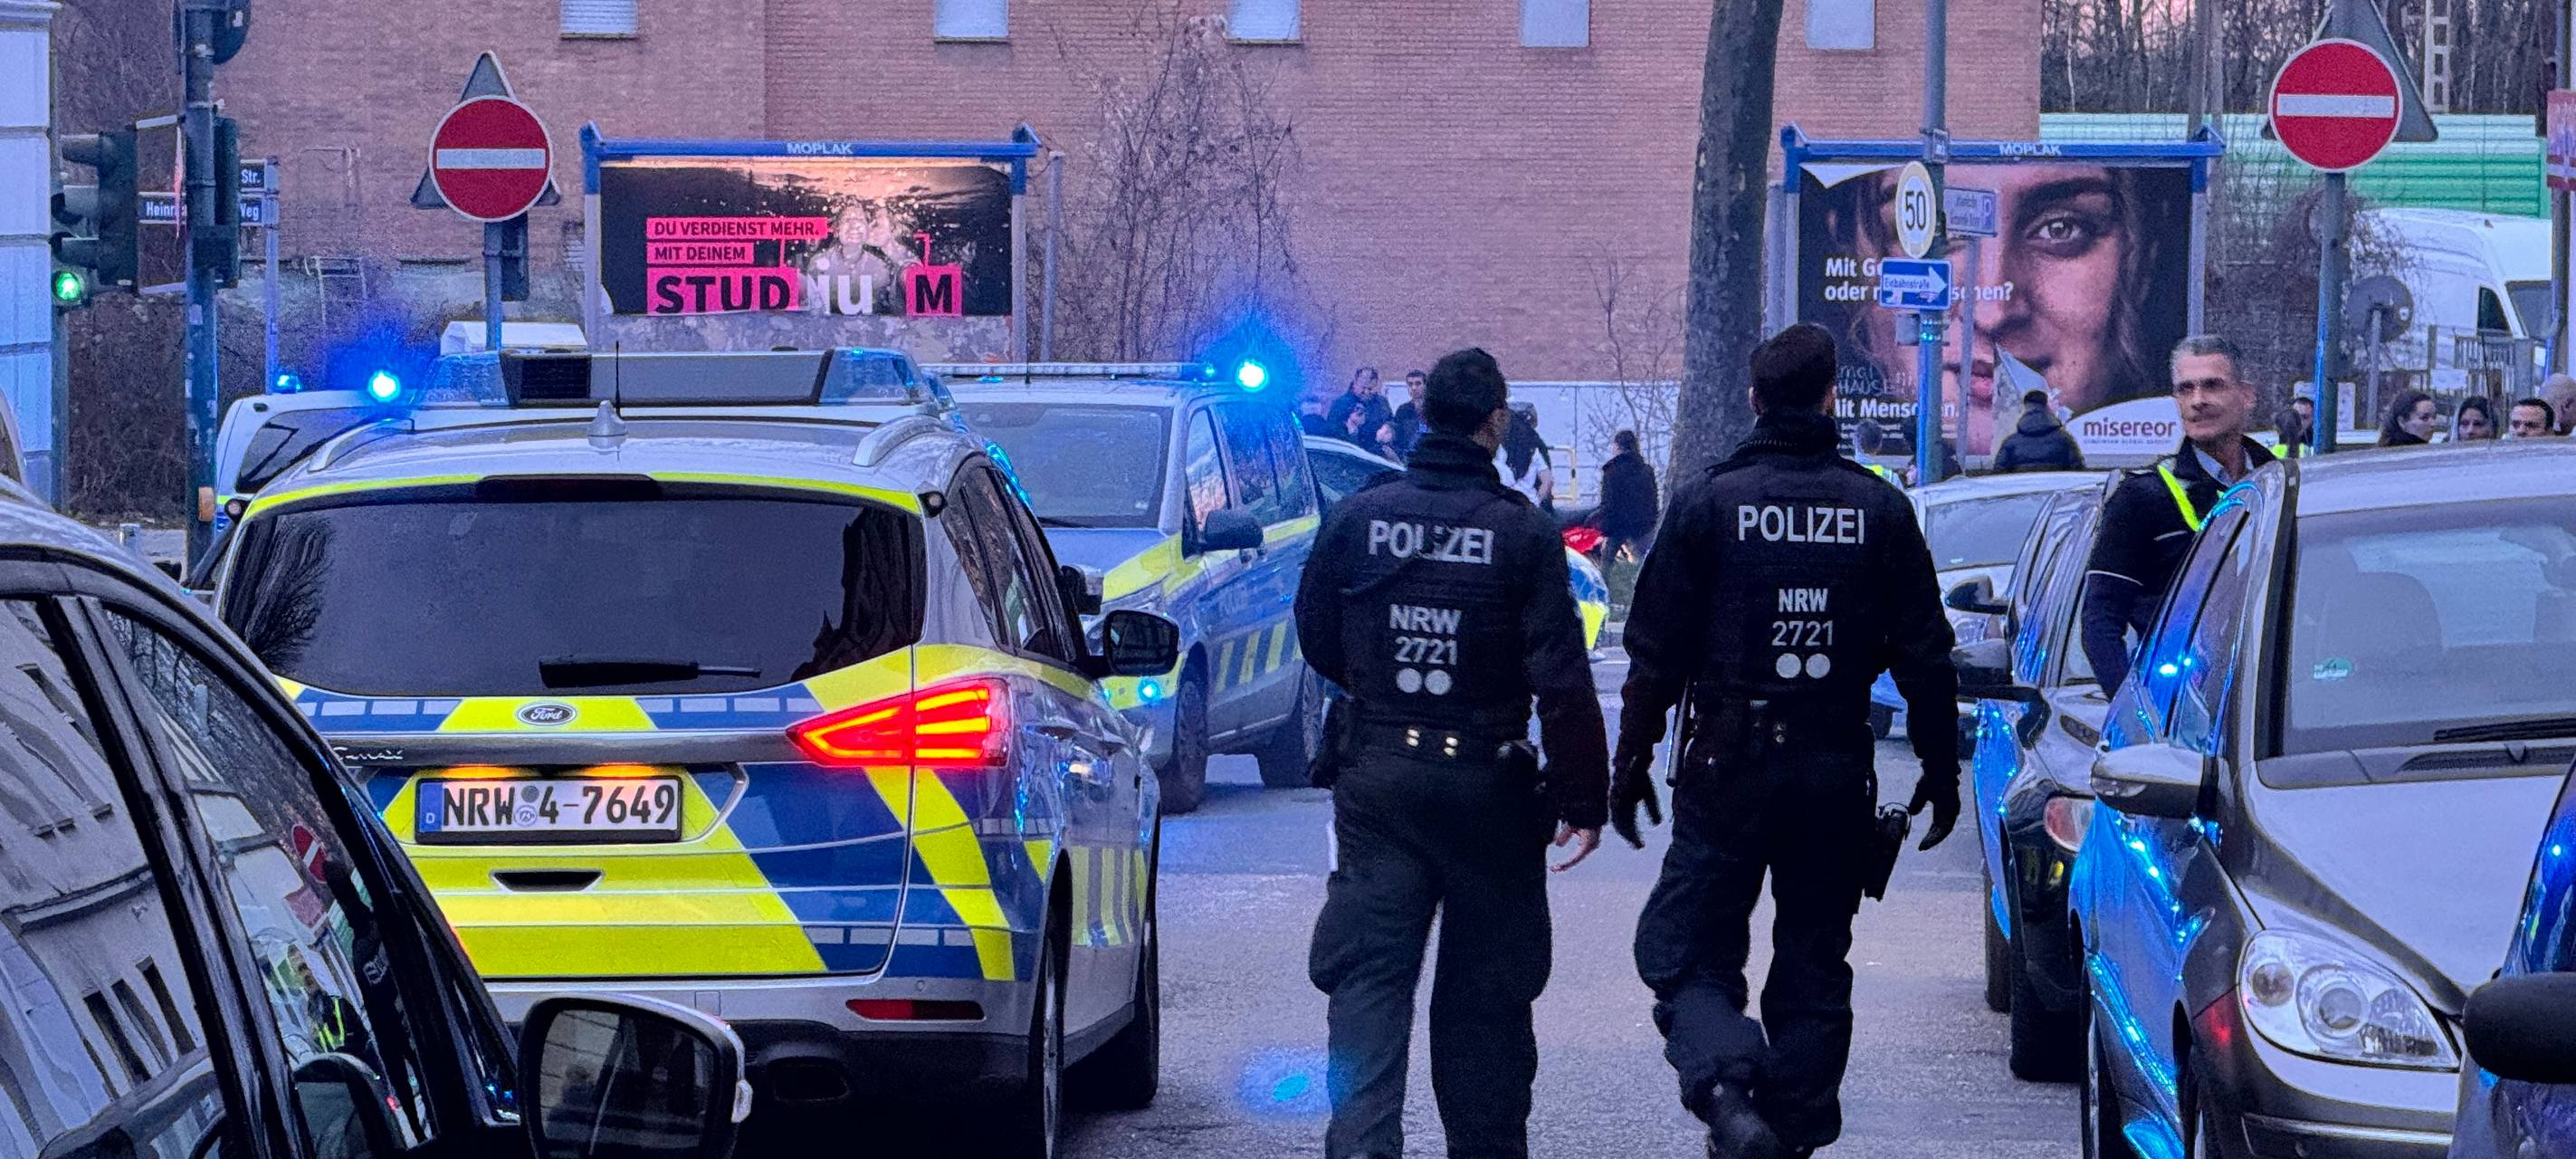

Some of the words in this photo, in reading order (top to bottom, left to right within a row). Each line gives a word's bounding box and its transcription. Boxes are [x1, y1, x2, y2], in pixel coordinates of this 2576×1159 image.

[787, 142, 854, 154] MOPLAK
[1999, 143, 2062, 156] MOPLAK
[241, 169, 262, 184] Str.
[1904, 191, 1927, 231] 50
[654, 222, 676, 235] DU
[681, 222, 768, 235] VERDIENST
[770, 222, 819, 235] MEHR.
[654, 246, 682, 260] MIT
[686, 246, 746, 260] DEINEM
[1825, 257, 1857, 278] Mit
[1824, 280, 1867, 302] oder
[2084, 417, 2177, 436] misereor
[1737, 504, 1865, 545] POLIZEI
[1778, 588, 1828, 613] NRW
[1388, 603, 1463, 634] NRW
[1770, 620, 1834, 647] 2721
[1394, 636, 1458, 666] 2721
[530, 707, 563, 721] Ford
[425, 812, 434, 824] D
[444, 786, 515, 827] NRW
